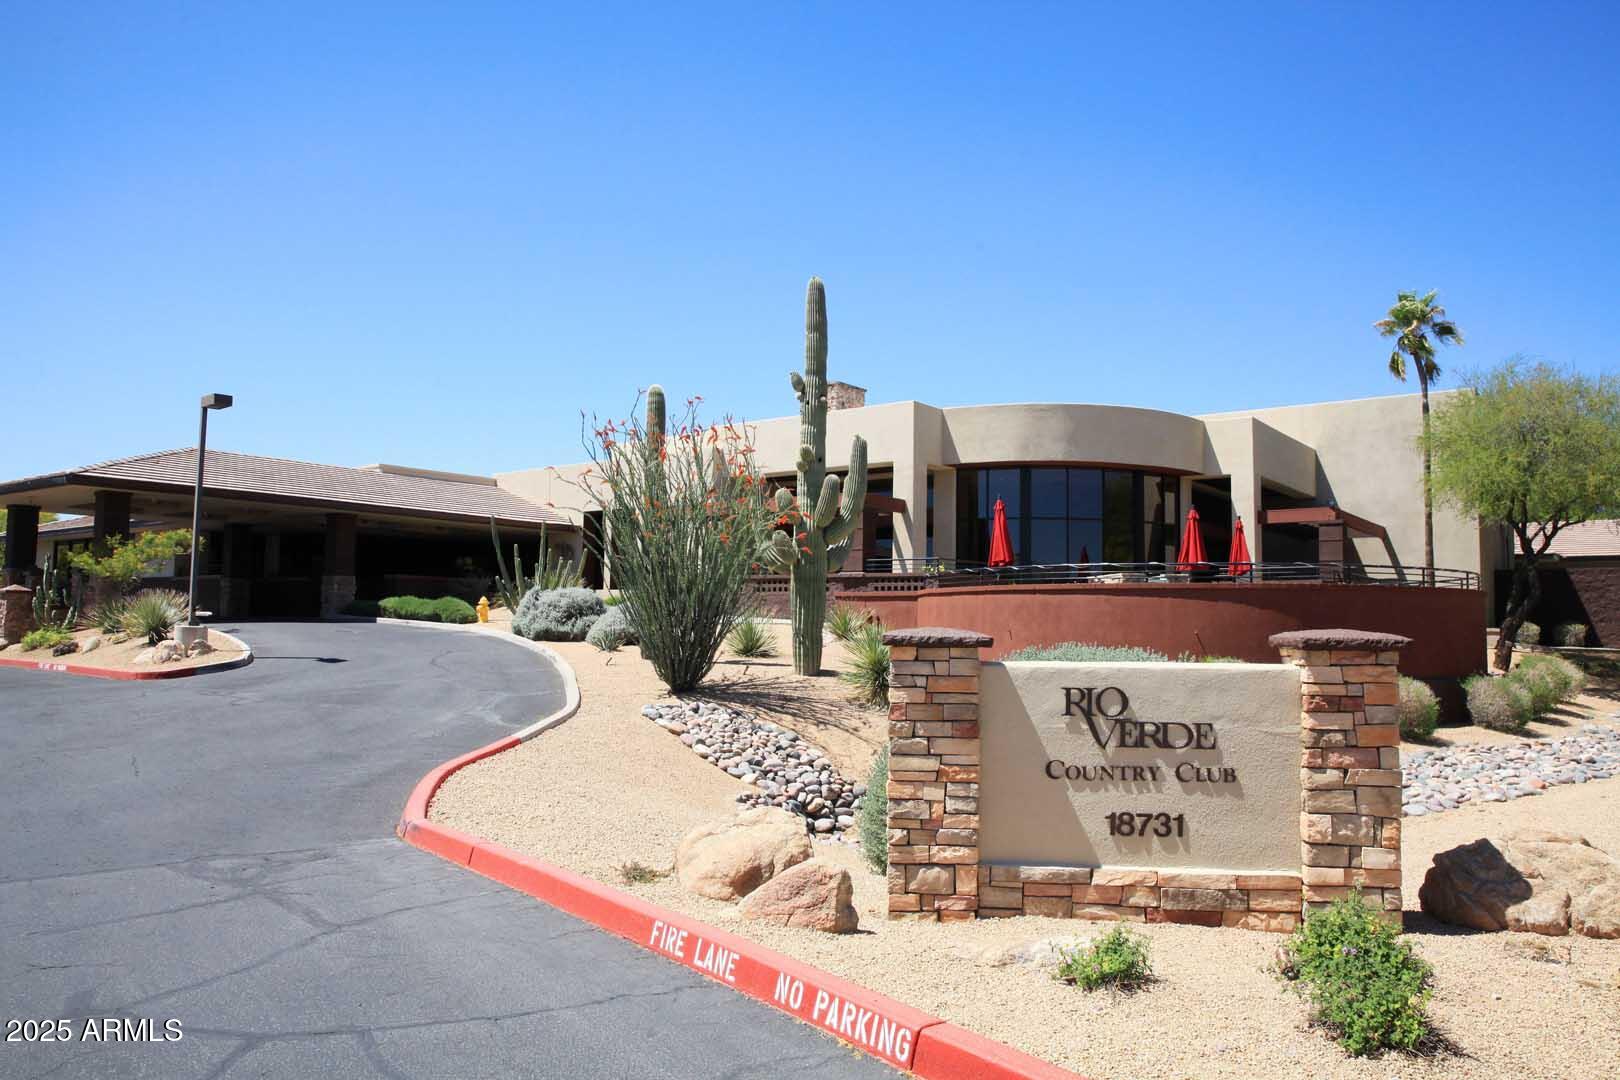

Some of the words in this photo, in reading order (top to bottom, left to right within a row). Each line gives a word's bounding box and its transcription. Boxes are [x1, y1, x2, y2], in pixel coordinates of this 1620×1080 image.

[1061, 686, 1129, 717] RIO
[1087, 717, 1217, 750] VERDE
[1045, 759, 1161, 782] COUNTRY
[1175, 762, 1237, 784] CLUB
[1105, 811, 1184, 837] 18731
[650, 919, 688, 958] FIRE
[693, 937, 741, 982] LANE
[774, 971, 804, 1010] NO
[812, 990, 913, 1063] PARKING
